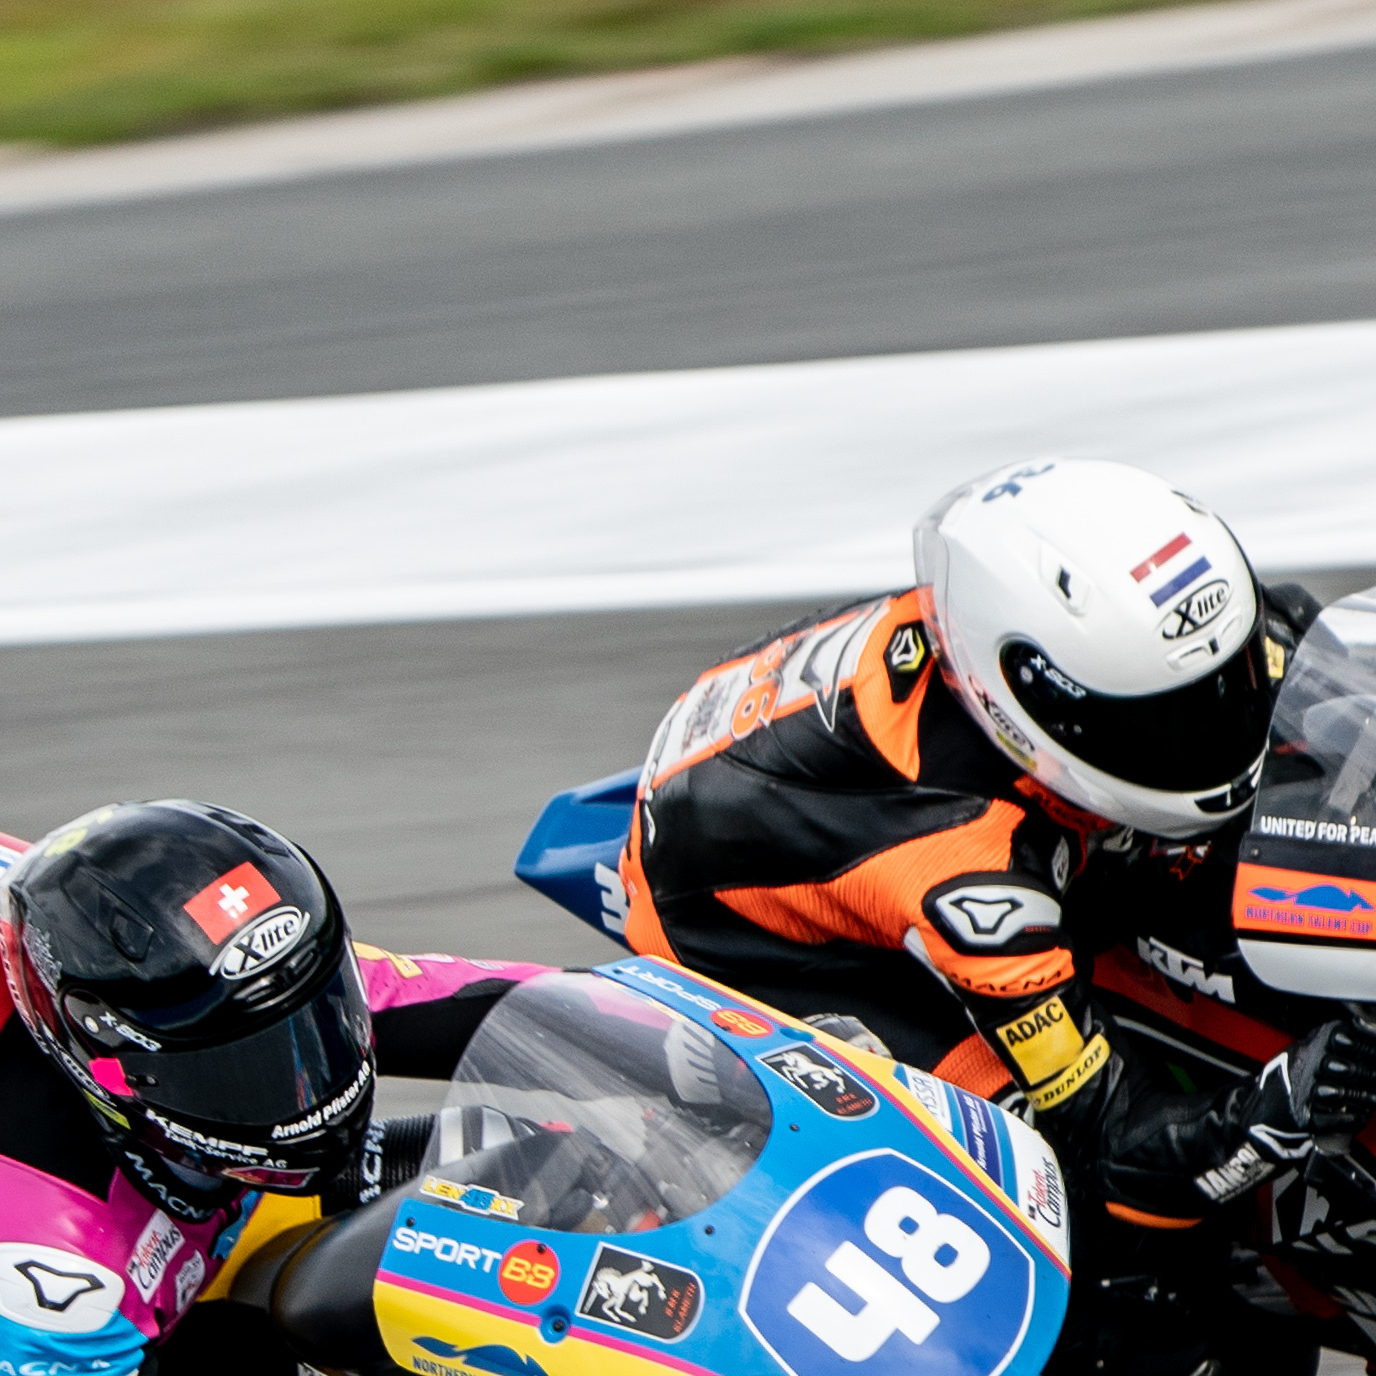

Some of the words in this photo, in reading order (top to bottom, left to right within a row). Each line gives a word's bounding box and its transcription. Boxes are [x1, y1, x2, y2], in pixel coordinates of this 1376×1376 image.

[1260, 815, 1317, 841] UNITED
[1317, 822, 1348, 844] FOR
[236, 921, 299, 975] X-lite
[1137, 936, 1236, 1004] KTM
[1005, 1001, 1064, 1047] ADAC
[1043, 1045, 1102, 1103] DUNLOP
[145, 1108, 269, 1157] KEMPF
[272, 1109, 322, 1139] Arnold
[392, 1226, 504, 1274] SPORT
[787, 1186, 991, 1363] 48
